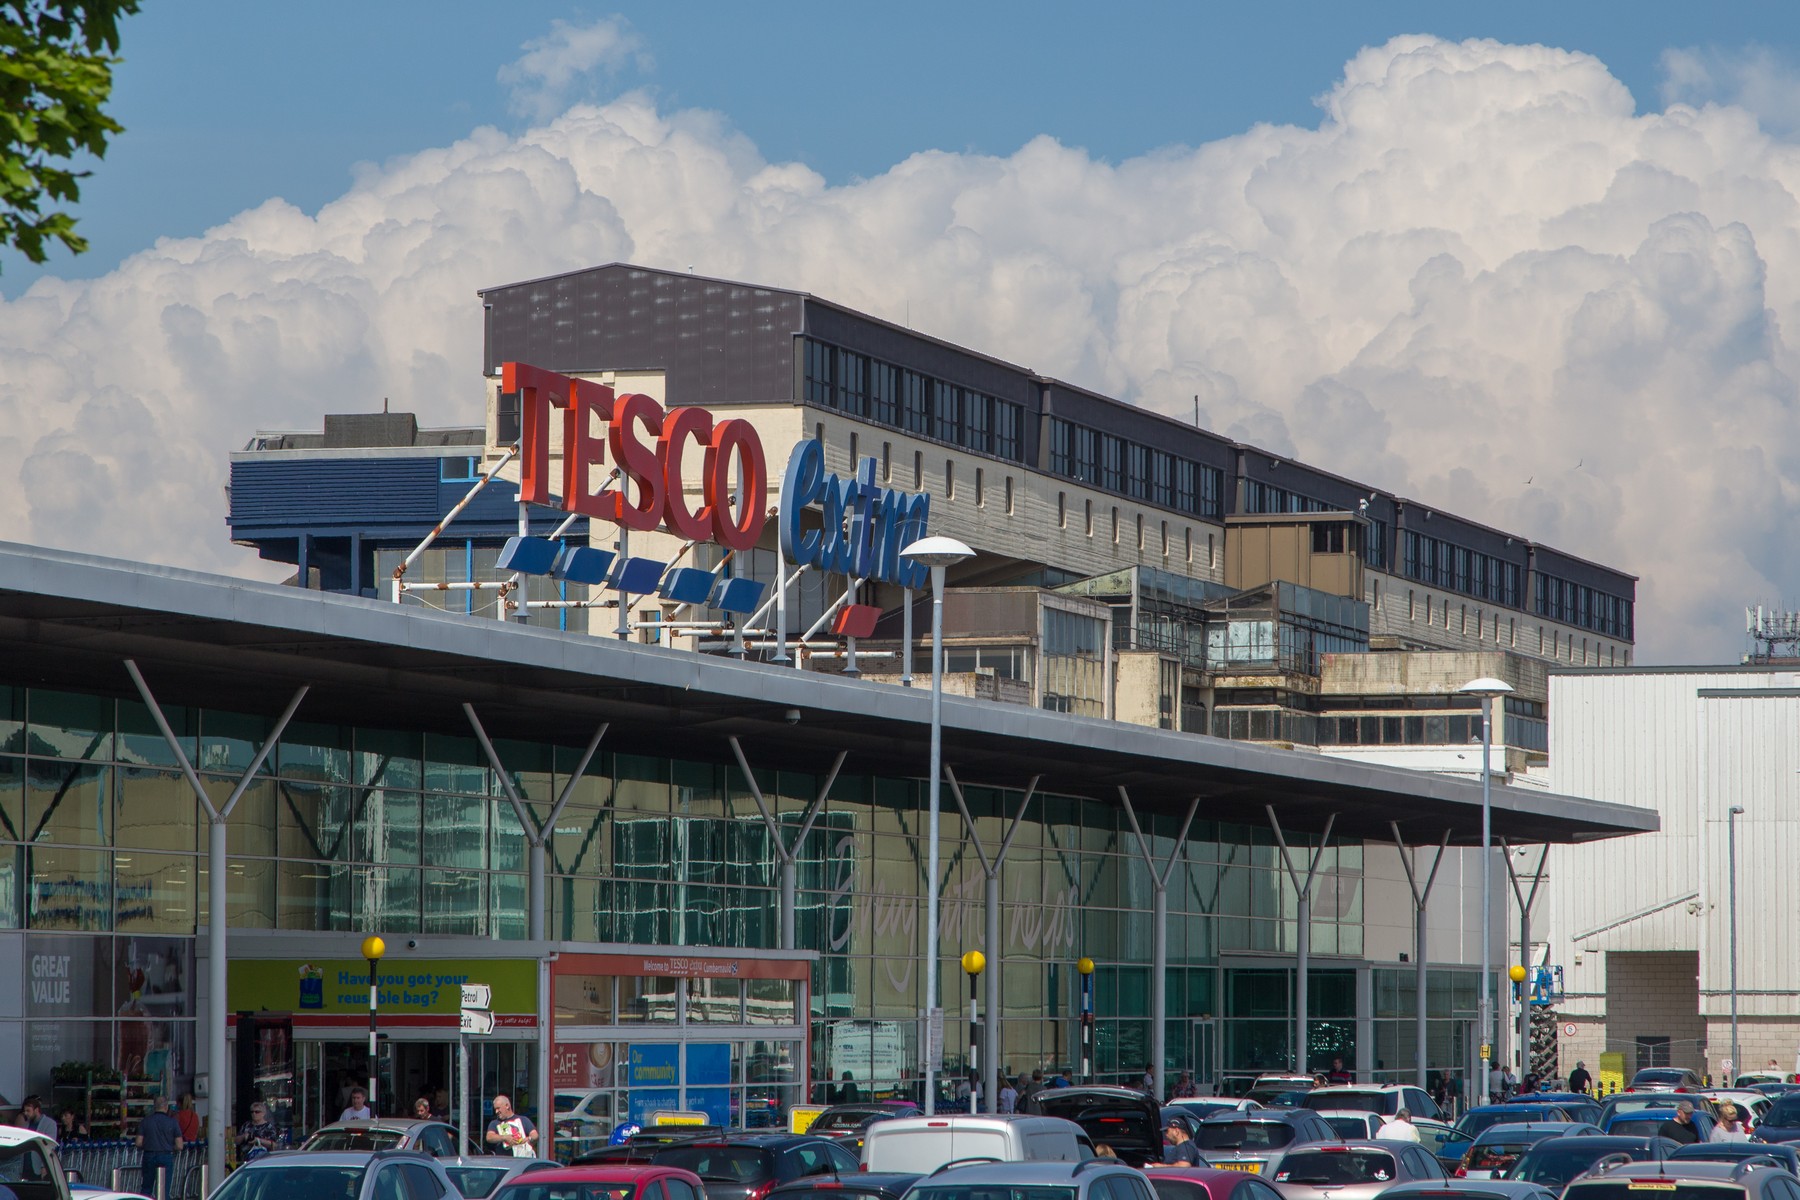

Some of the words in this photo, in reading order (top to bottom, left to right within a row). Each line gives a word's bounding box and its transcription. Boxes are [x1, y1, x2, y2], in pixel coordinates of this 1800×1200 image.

[502, 361, 767, 551] TESCO
[781, 439, 930, 590] extra
[829, 836, 917, 993] Every
[1010, 869, 1079, 978] helps
[32, 954, 70, 978] GREAT
[643, 959, 664, 971] Welcome
[664, 962, 669, 972] to
[670, 958, 688, 970] TESCO
[377, 974, 404, 987] you
[408, 973, 432, 988] got
[435, 974, 468, 987] your
[32, 980, 70, 1003] VALUE
[338, 991, 400, 1004] reusble
[404, 990, 439, 1007] bag?
[461, 989, 478, 1003] Petrol
[460, 1014, 472, 1028] Exit
[1567, 1025, 1574, 1034] 5
[632, 1049, 643, 1064] Our
[1481, 1046, 1490, 1056] H
[634, 1060, 676, 1084] community
